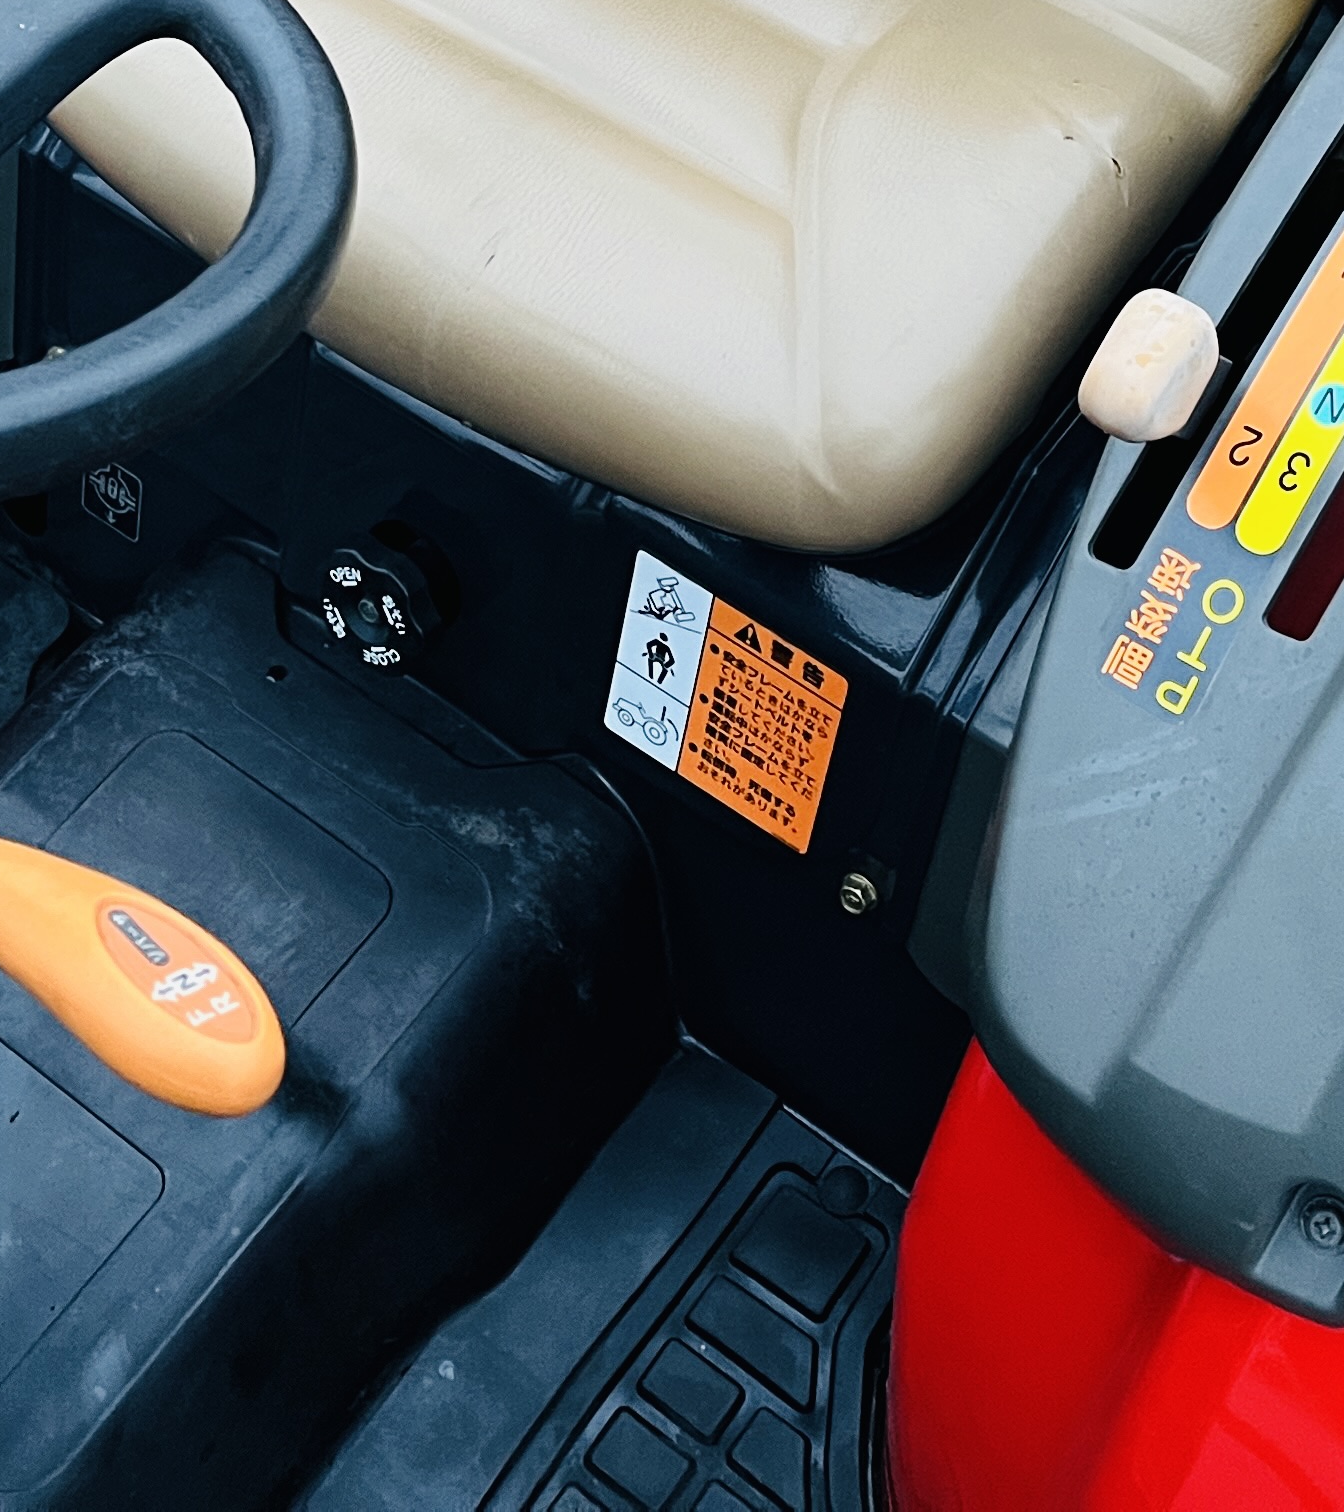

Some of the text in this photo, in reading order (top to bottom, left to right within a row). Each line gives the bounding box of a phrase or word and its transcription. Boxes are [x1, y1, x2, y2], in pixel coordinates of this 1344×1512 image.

[1229, 426, 1263, 466] 2
[1278, 452, 1311, 492] 3
[330, 567, 361, 582] OPEN
[1100, 547, 1202, 690] 副変速
[363, 649, 400, 666] CLOSE
[1155, 579, 1245, 715] PTO
[172, 973, 197, 990] N
[186, 991, 240, 1027] F R
